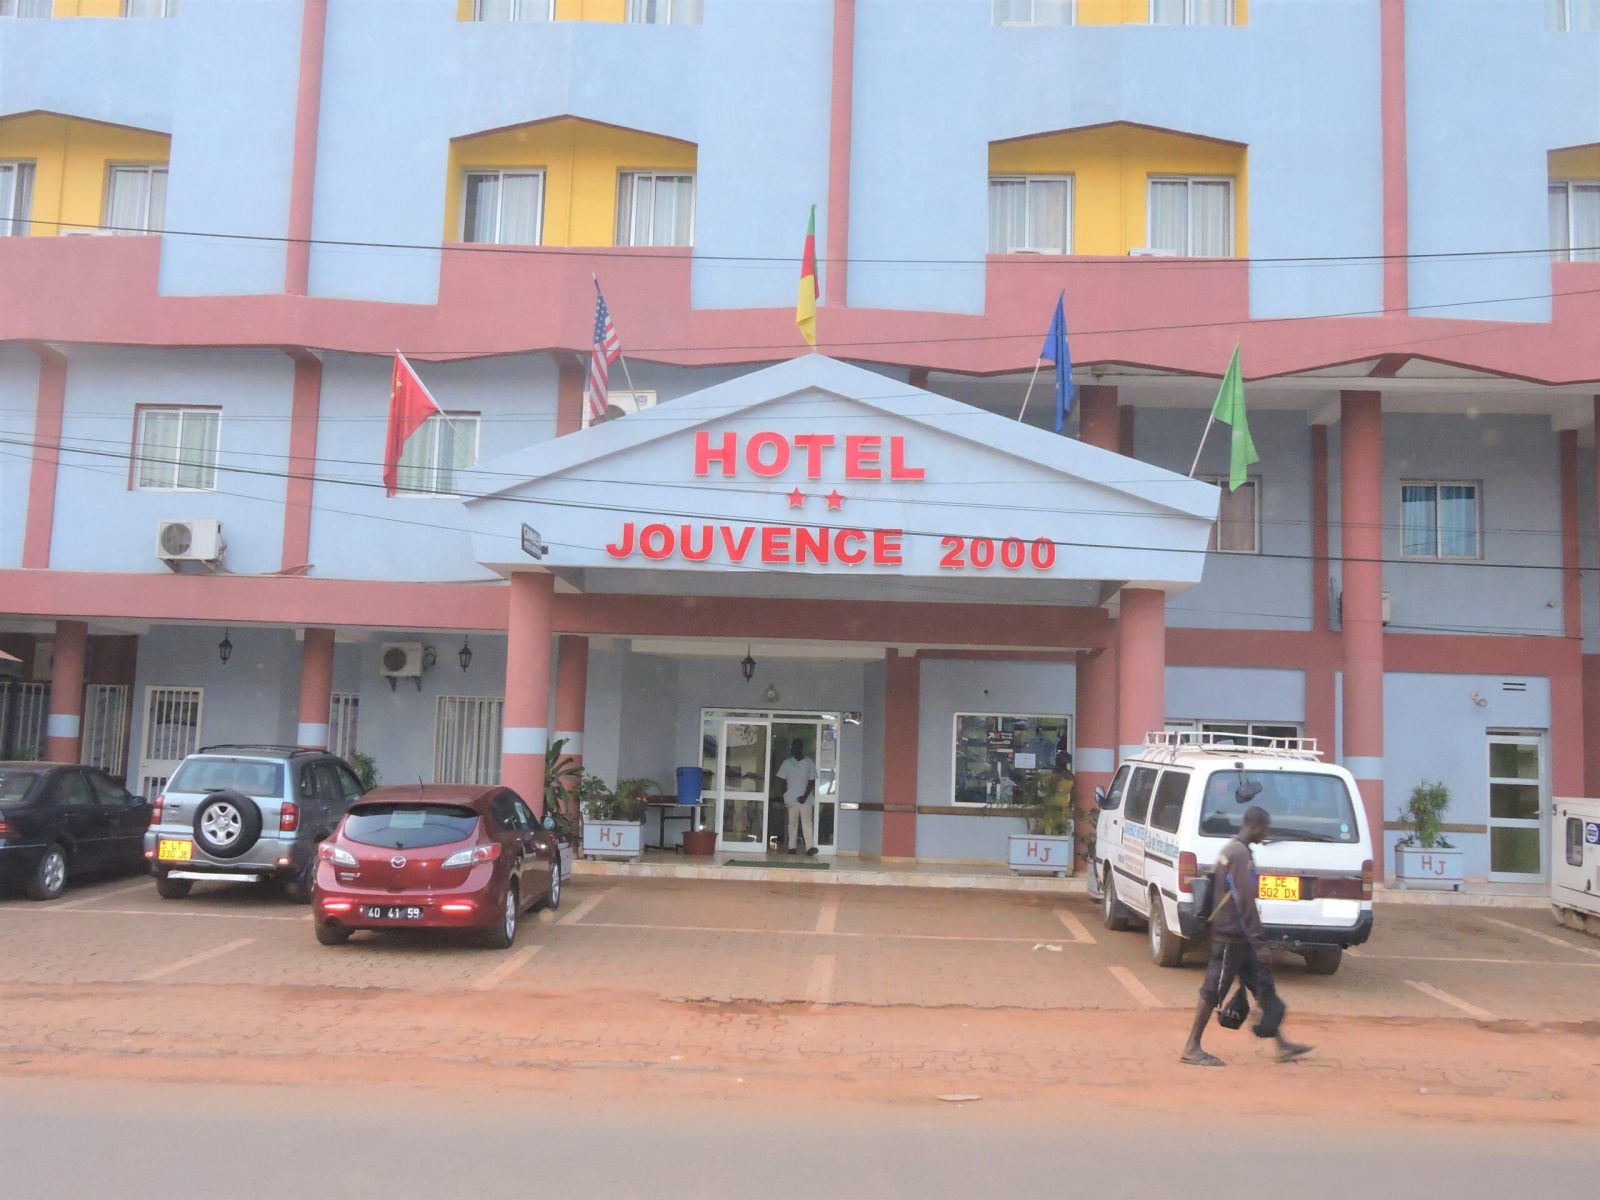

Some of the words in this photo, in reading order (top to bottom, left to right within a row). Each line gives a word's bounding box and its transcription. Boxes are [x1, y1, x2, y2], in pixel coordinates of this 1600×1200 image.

[694, 431, 926, 481] HOTEL
[605, 522, 904, 566] JOUVENCE
[939, 536, 1057, 570] 2000
[1275, 877, 1287, 887] CE
[1260, 887, 1279, 898] 502
[1284, 888, 1297, 899] DX
[368, 907, 381, 918] 40
[388, 908, 399, 918] 41
[407, 908, 420, 919] 59
